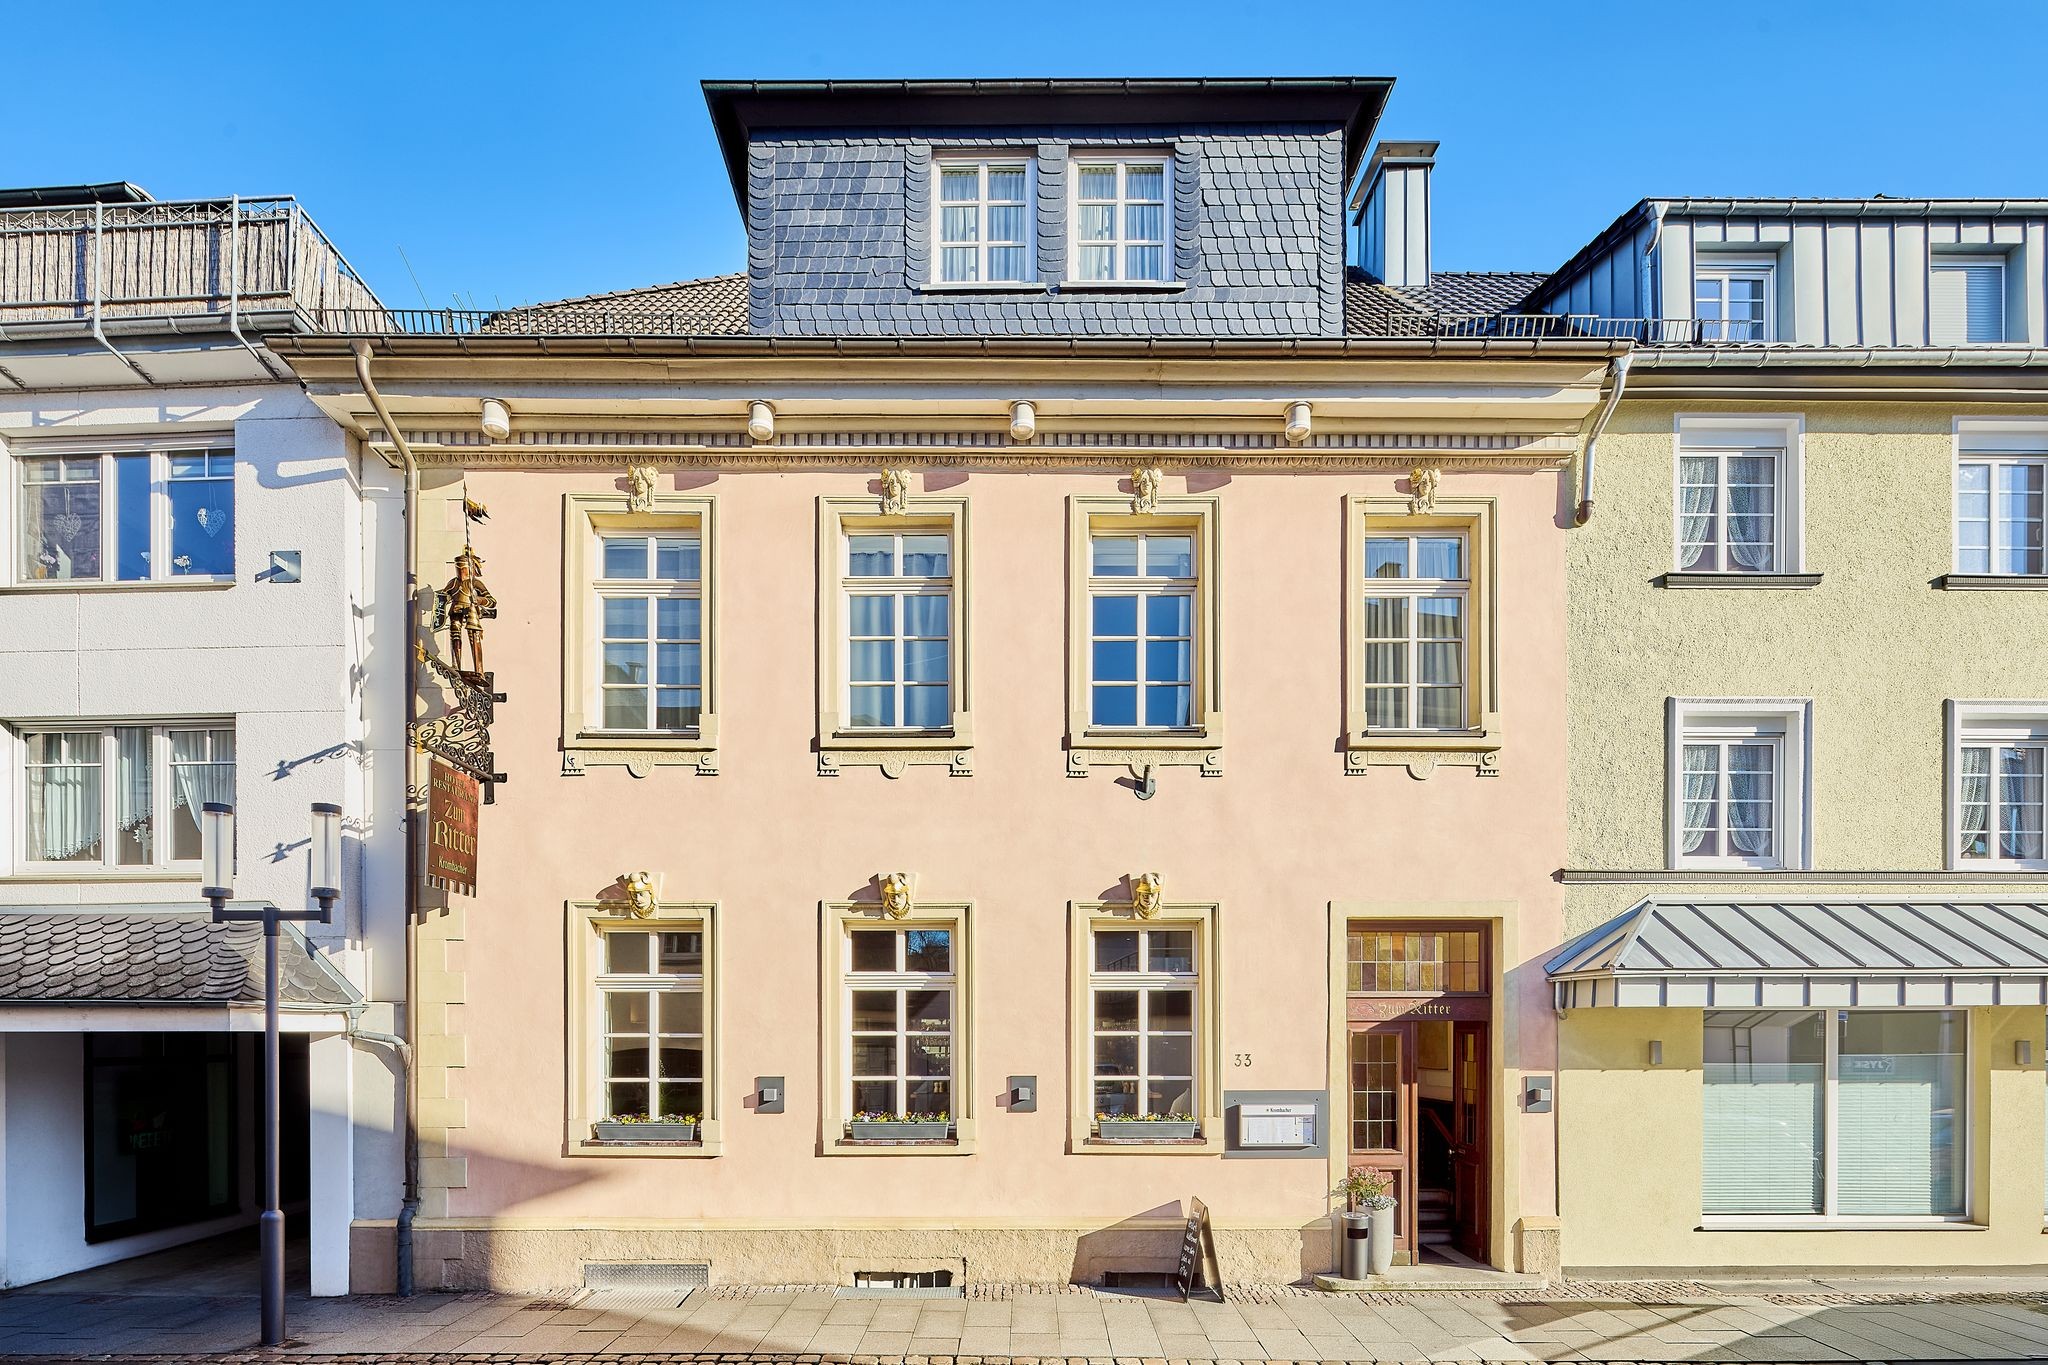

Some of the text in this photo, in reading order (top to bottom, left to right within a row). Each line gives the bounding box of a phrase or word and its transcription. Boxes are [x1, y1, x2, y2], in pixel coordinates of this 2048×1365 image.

[444, 772, 467, 789] HOTEL
[444, 799, 466, 823] Zum
[432, 817, 476, 856] Ritter
[438, 855, 467, 875] Krombacher
[1378, 1000, 1451, 1017] Zum Ritter
[1234, 1053, 1252, 1067] 33
